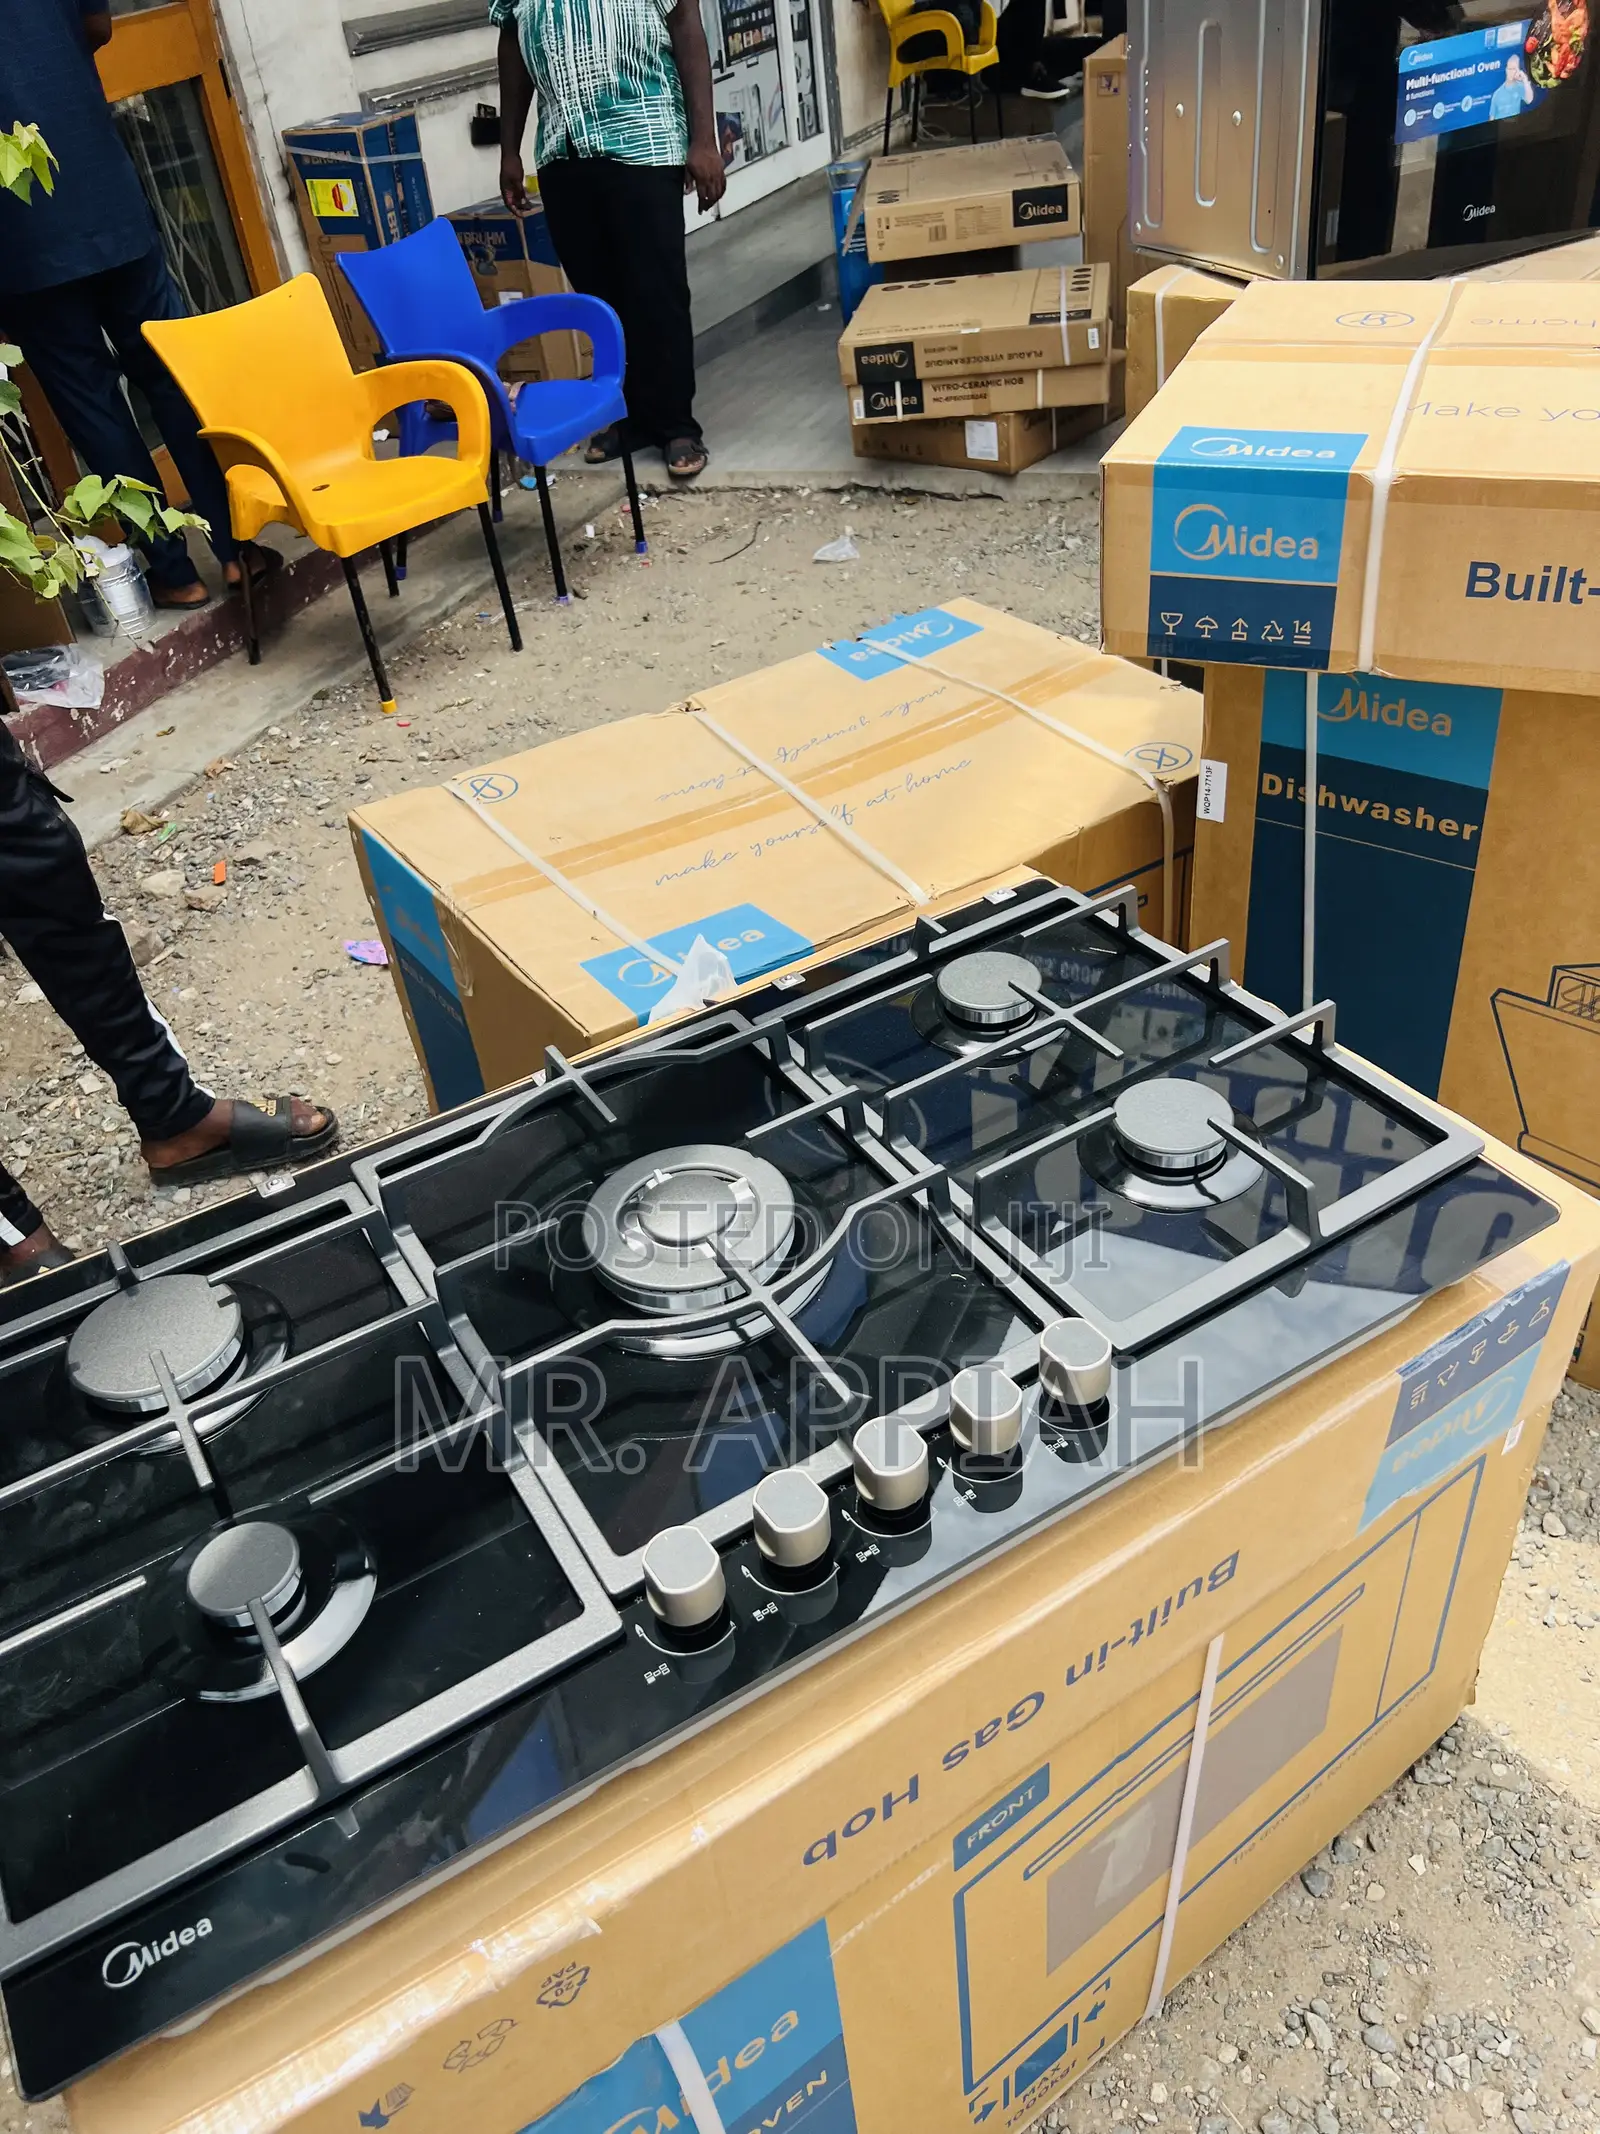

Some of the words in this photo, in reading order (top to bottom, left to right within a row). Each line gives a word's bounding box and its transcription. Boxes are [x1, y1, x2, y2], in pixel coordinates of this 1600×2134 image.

[1406, 64, 1476, 90] Multi-functional
[1477, 60, 1501, 73] Oven
[1018, 202, 1064, 220] Midea
[1463, 204, 1497, 222] Midea
[860, 350, 909, 369] Midea
[1007, 350, 1044, 362] PLAQUE
[931, 378, 1003, 392] VITRO-CERAMIC
[1190, 437, 1337, 460] Midea
[1173, 503, 1318, 561] Midea
[1293, 620, 1312, 634] 14
[1317, 686, 1453, 737] Midea
[1203, 764, 1214, 816] WQP14-7713F
[1261, 772, 1479, 841] Dishwasher
[655, 849, 738, 887] make
[866, 788, 902, 809] at
[905, 758, 973, 794] home
[1063, 1549, 1241, 1689] Built-in
[942, 1690, 1046, 1772] Gas
[802, 1773, 921, 1867] Hob
[964, 1785, 1038, 1847] FRONT
[102, 1916, 213, 1990] Midea
[540, 1961, 577, 1990] PAP
[554, 1980, 575, 1998] 20
[1022, 2062, 1061, 2103] MAX
